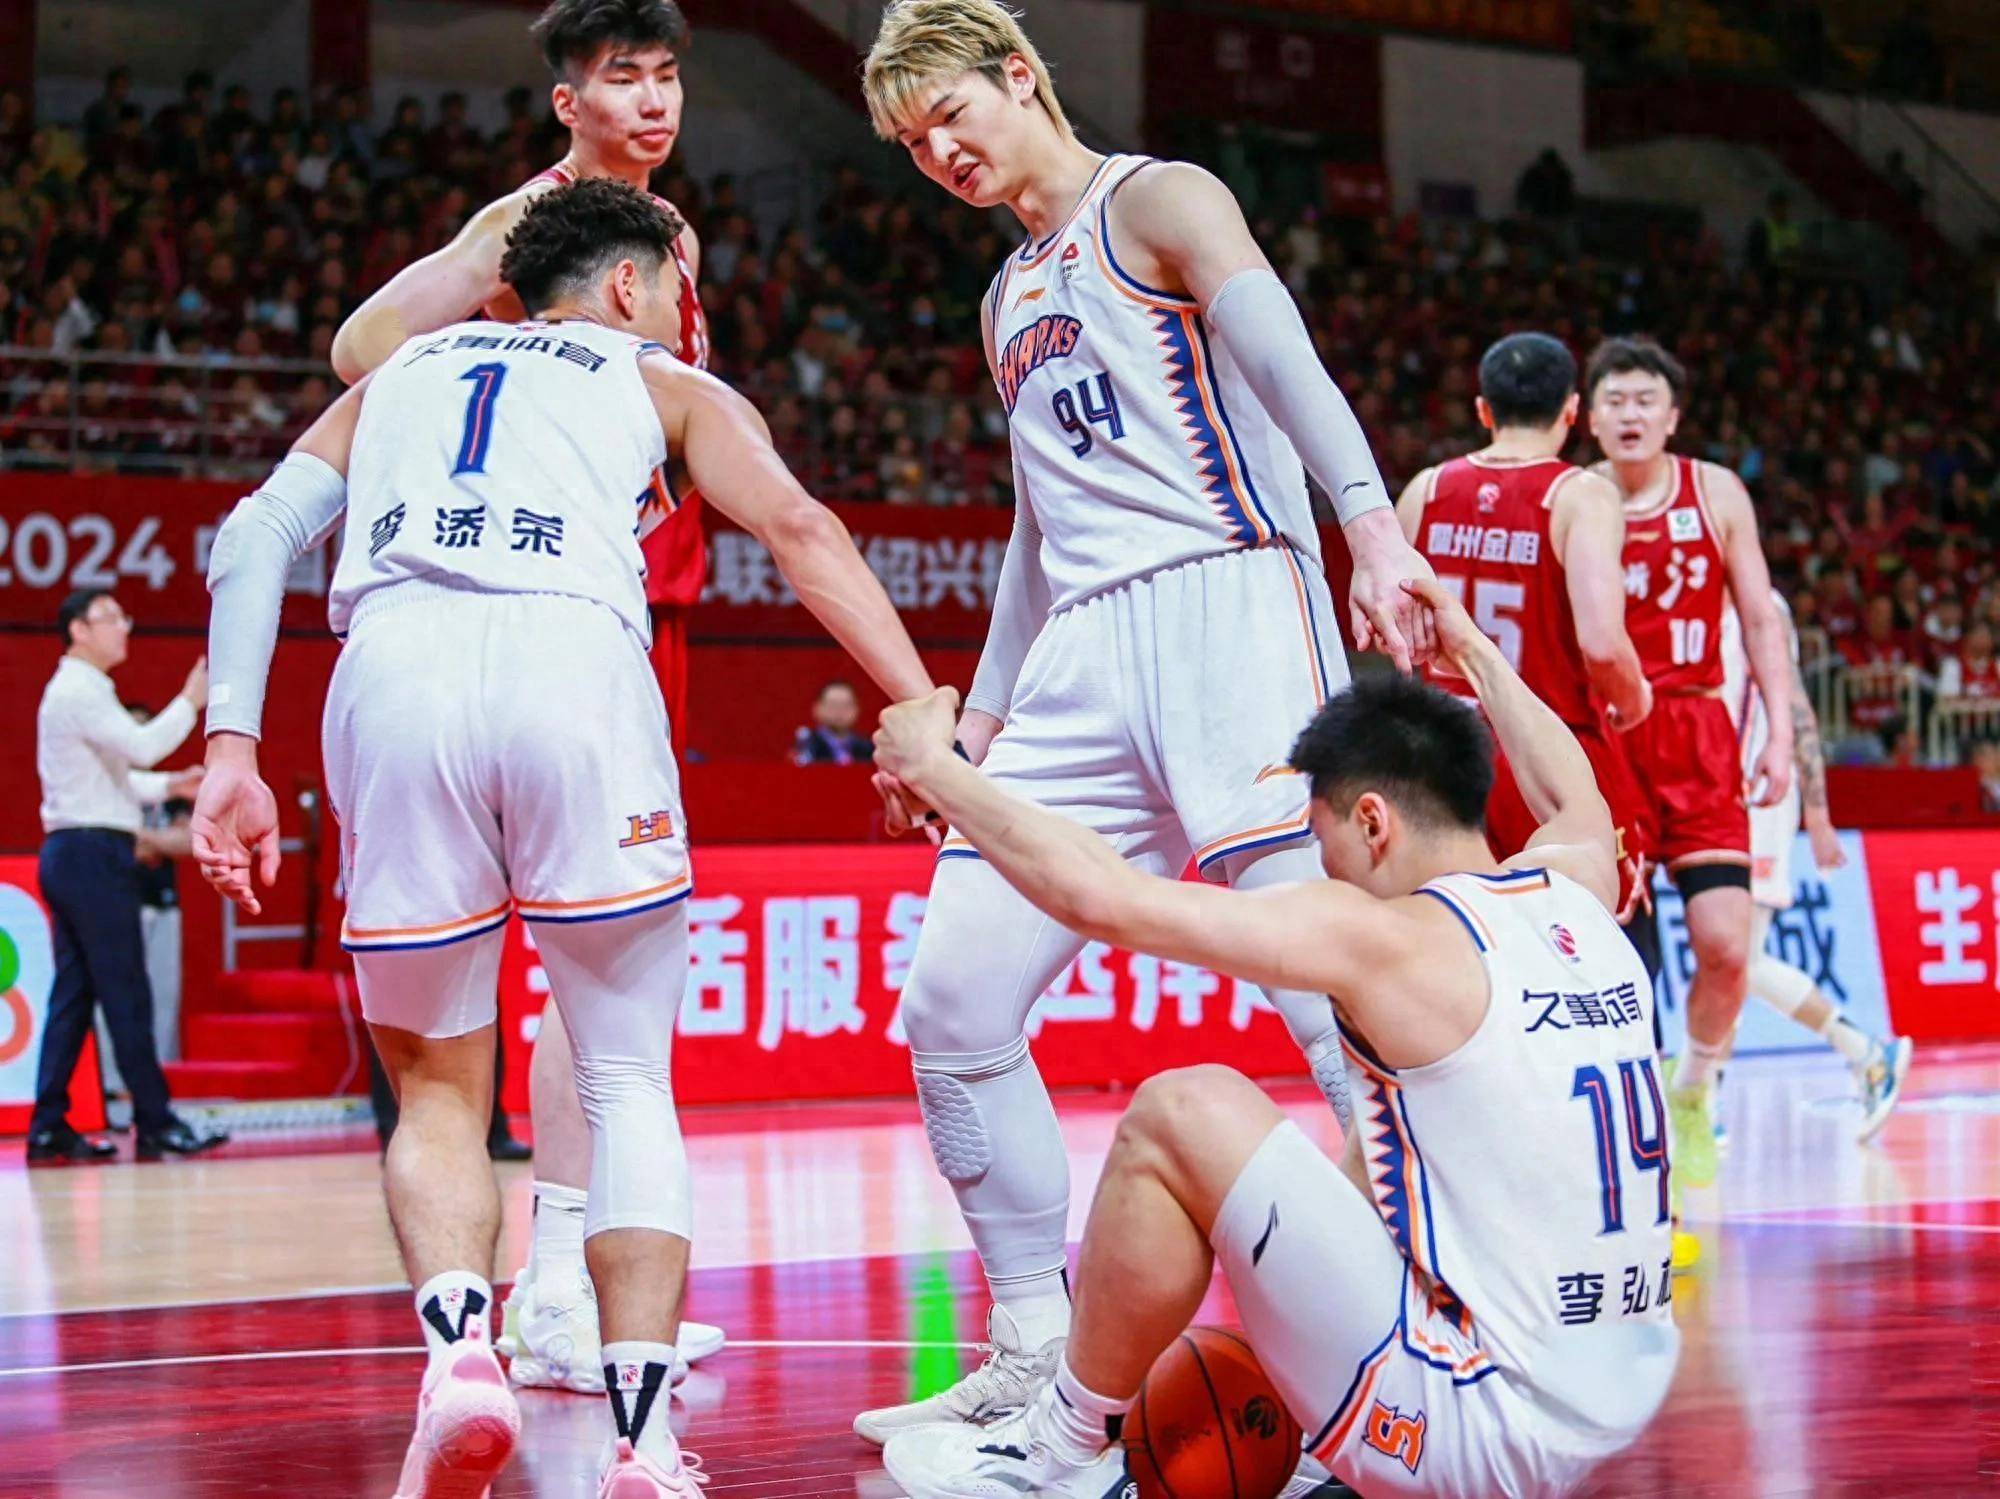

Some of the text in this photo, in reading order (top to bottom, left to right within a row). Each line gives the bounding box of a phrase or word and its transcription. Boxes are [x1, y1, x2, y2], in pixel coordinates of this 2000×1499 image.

[1000, 314, 1083, 418] HARKS
[453, 361, 509, 476] 1
[1052, 371, 1127, 459] 94
[0, 513, 176, 589] 024
[369, 502, 564, 557] 李添荣
[1669, 618, 1707, 666] 10
[1914, 866, 2000, 994] 生
[1569, 1056, 1670, 1235] 14
